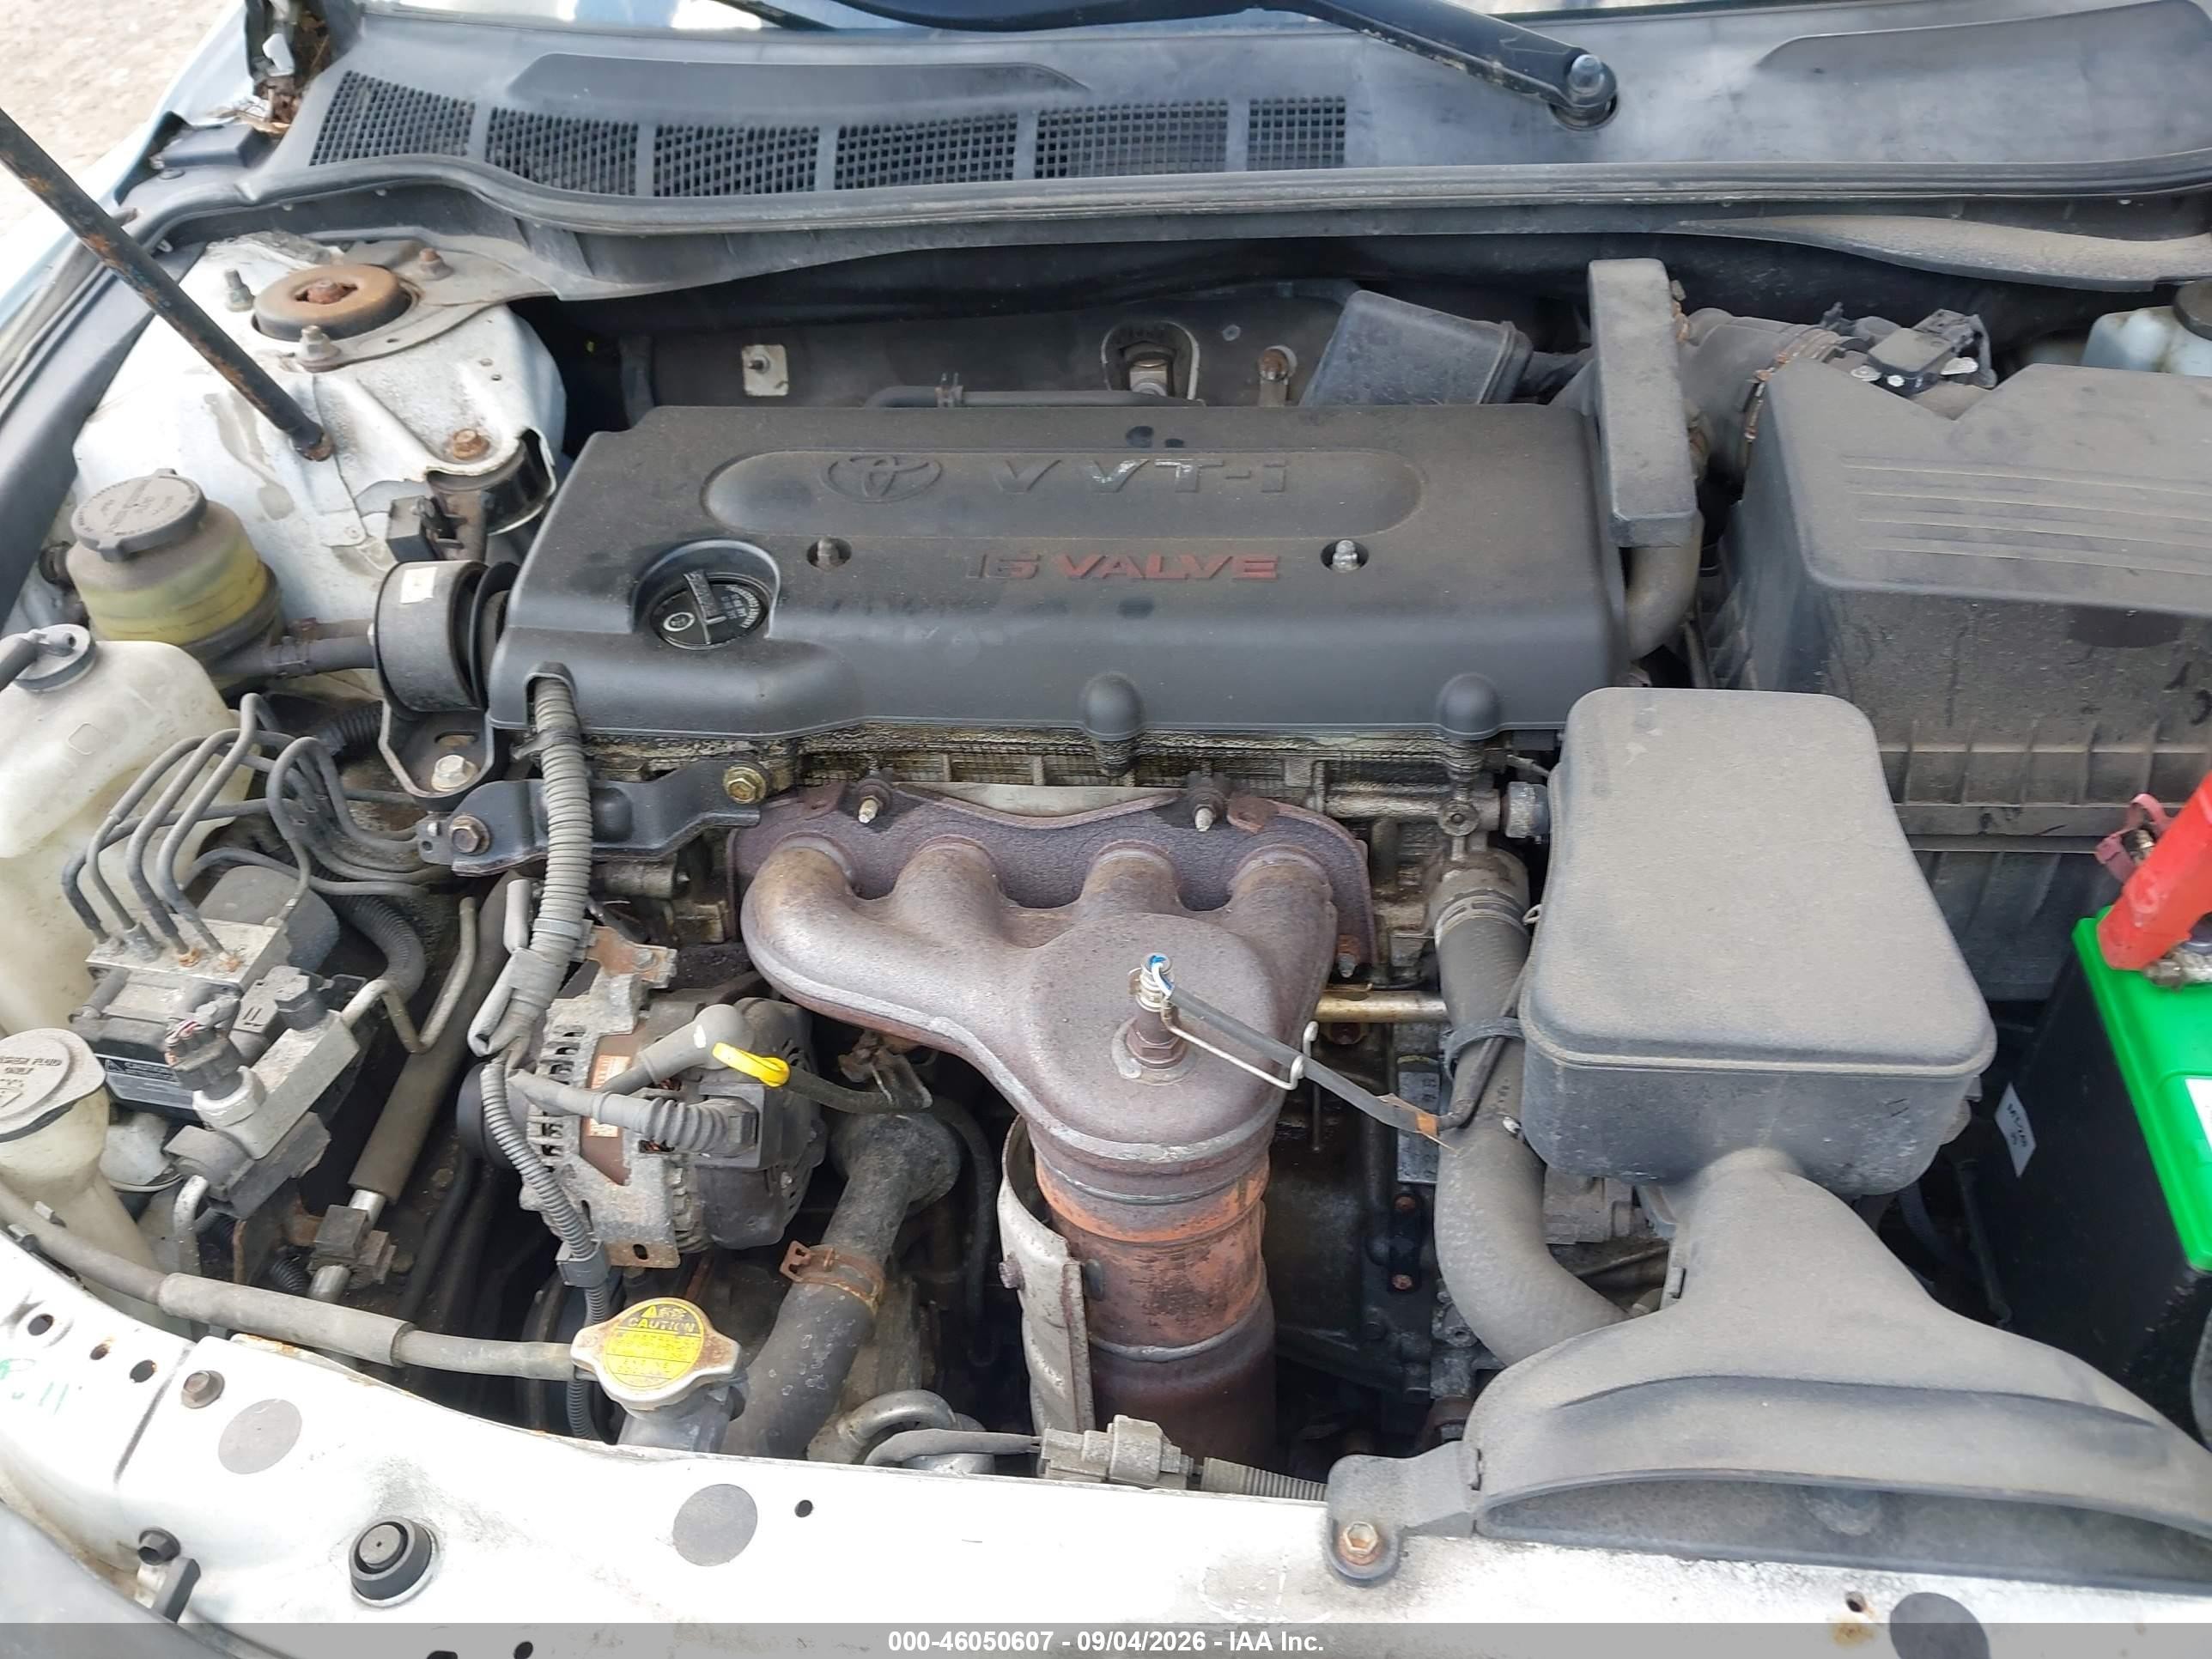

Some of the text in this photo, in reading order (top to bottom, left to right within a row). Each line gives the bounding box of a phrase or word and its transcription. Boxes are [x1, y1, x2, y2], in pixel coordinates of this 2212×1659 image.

[966, 552, 1284, 580] 16 VALVE
[629, 1316, 695, 1331] CAUTION
